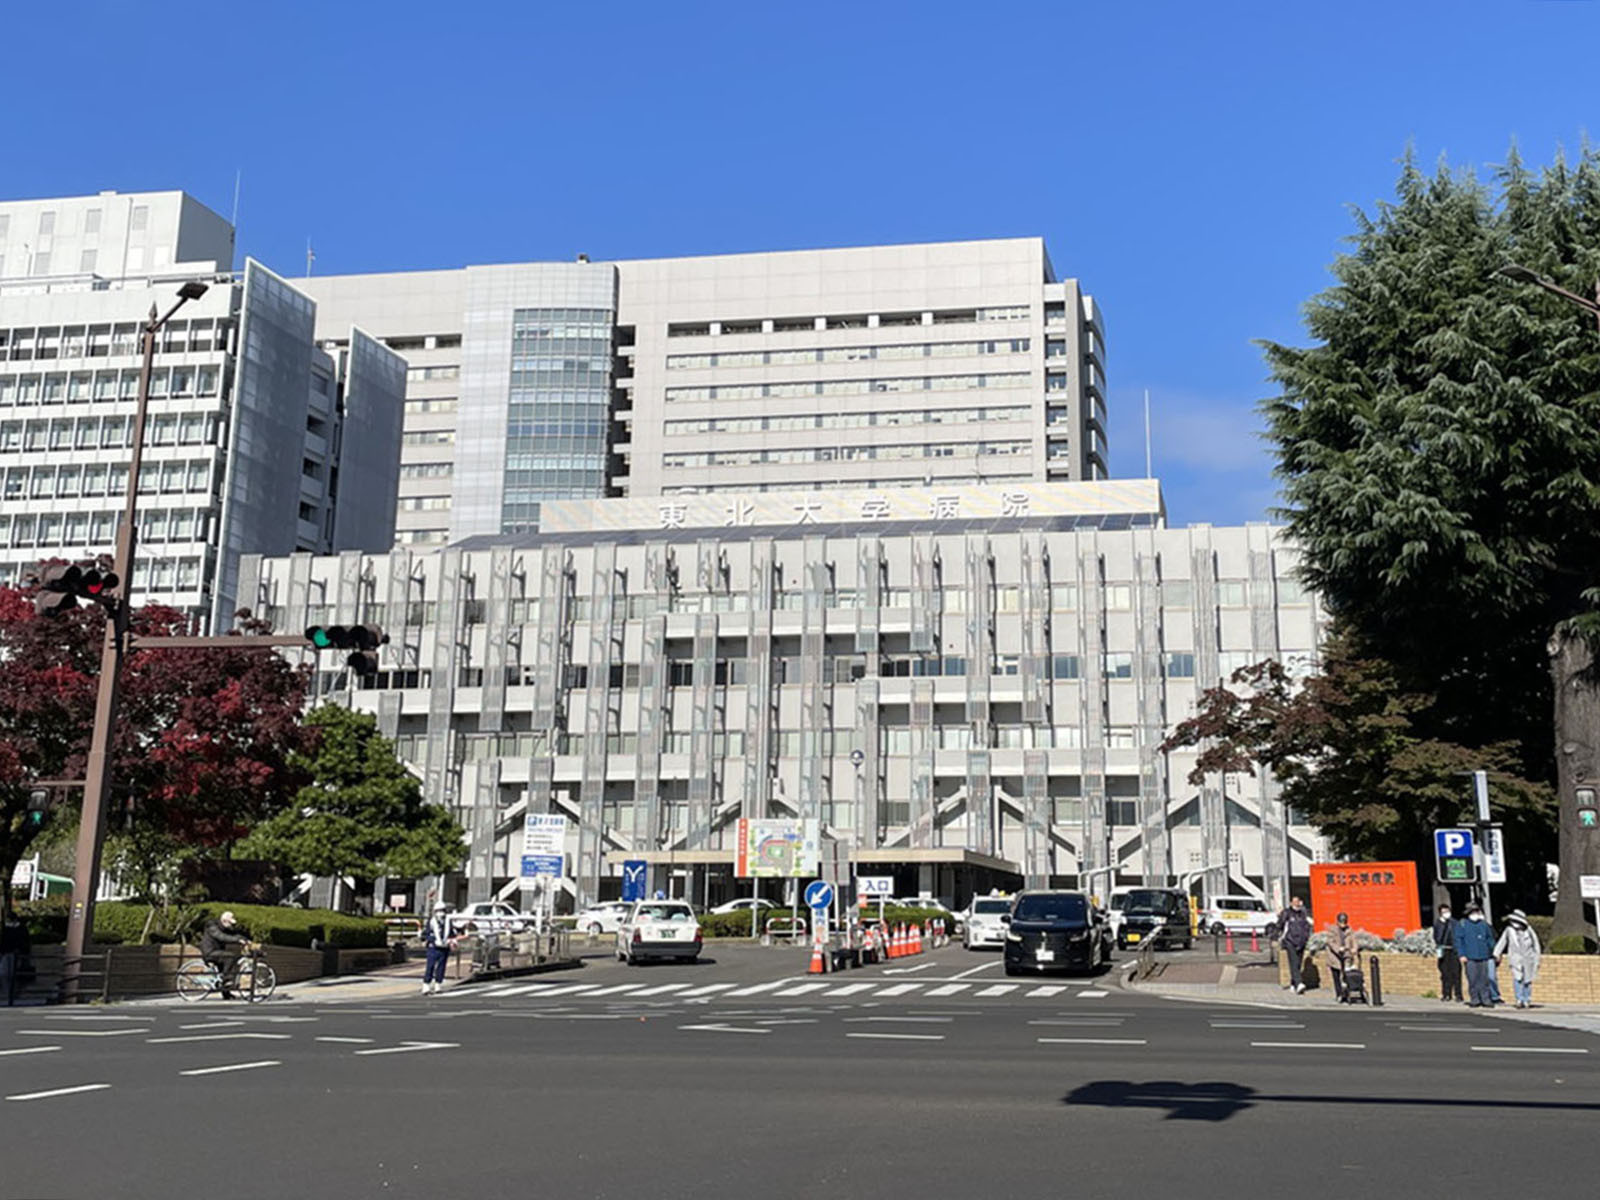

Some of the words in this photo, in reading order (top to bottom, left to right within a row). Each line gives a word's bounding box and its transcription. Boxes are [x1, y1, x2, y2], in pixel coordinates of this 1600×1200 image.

[658, 490, 1030, 529] 東北大学病院
[1445, 833, 1465, 856] P
[865, 880, 889, 892] 入口
[1325, 872, 1395, 886] 東北大学病院
